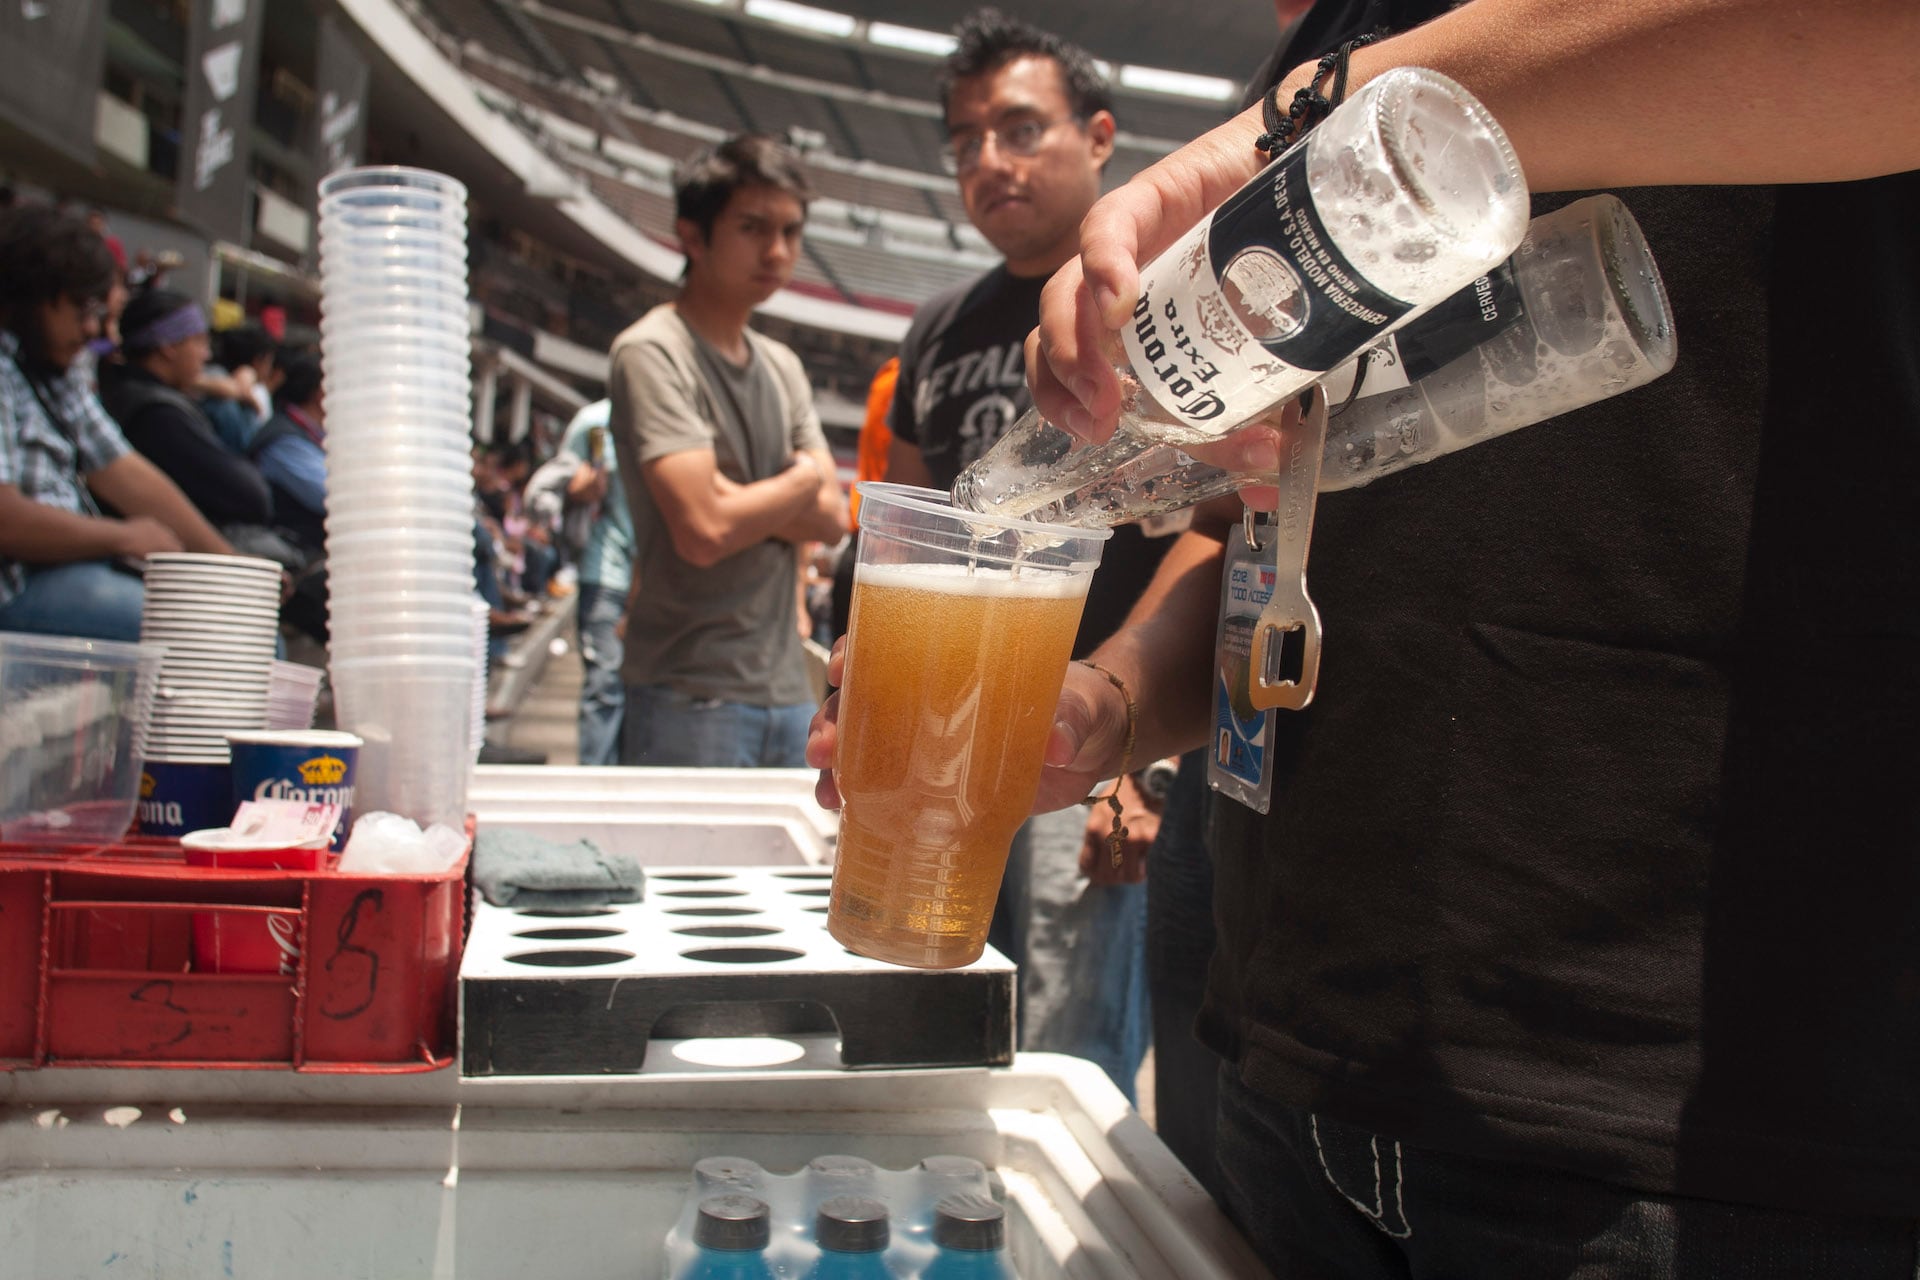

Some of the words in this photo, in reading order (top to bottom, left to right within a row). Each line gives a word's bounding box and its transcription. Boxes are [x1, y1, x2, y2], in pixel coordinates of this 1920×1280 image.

[1294, 208, 1321, 250] MEXICO
[1314, 248, 1330, 265] EN
[1328, 263, 1360, 294] HECHO
[1475, 272, 1498, 322] CERVEC
[1321, 285, 1388, 326] CERVECERIA
[1132, 291, 1227, 420] Corona
[1164, 297, 1222, 385] Extra
